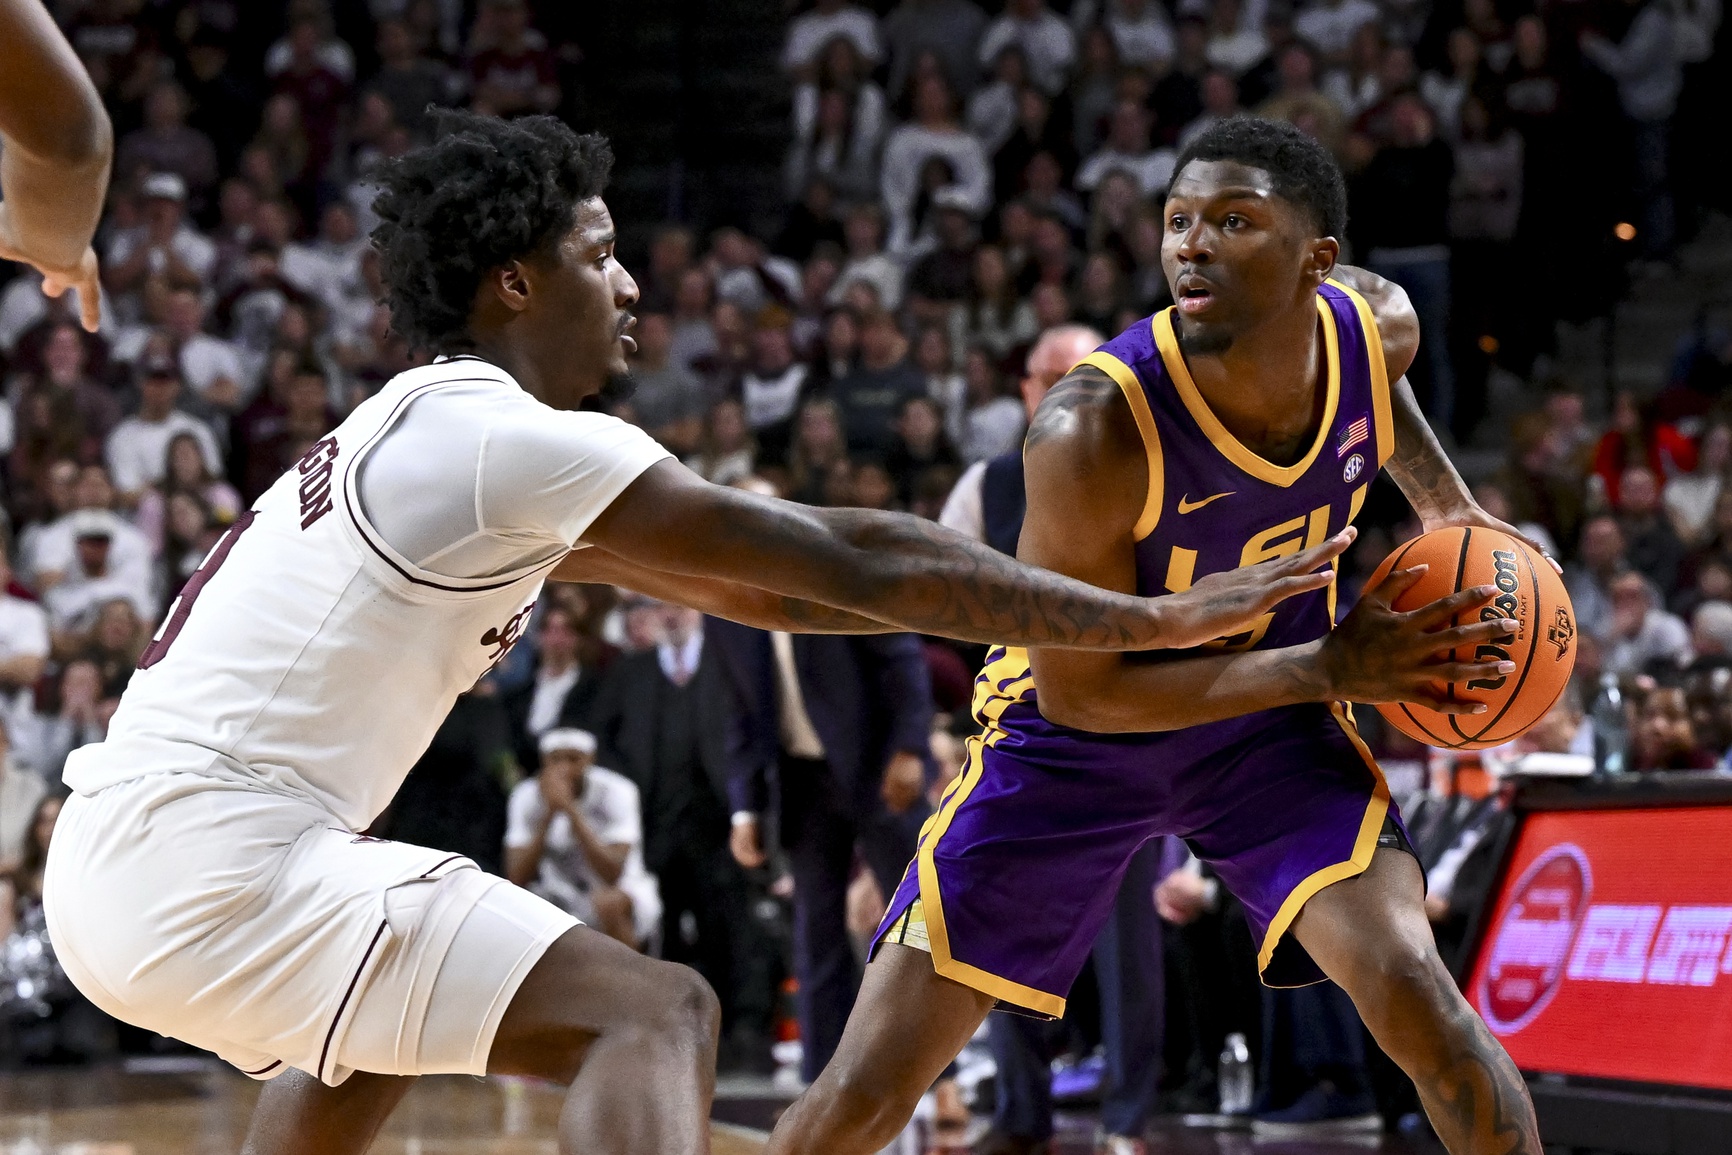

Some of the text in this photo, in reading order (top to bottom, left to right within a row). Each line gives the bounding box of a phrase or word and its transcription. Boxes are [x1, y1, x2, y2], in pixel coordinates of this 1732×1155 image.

[1345, 455, 1363, 481] SEC
[1517, 595, 1528, 640] EVO NXT
